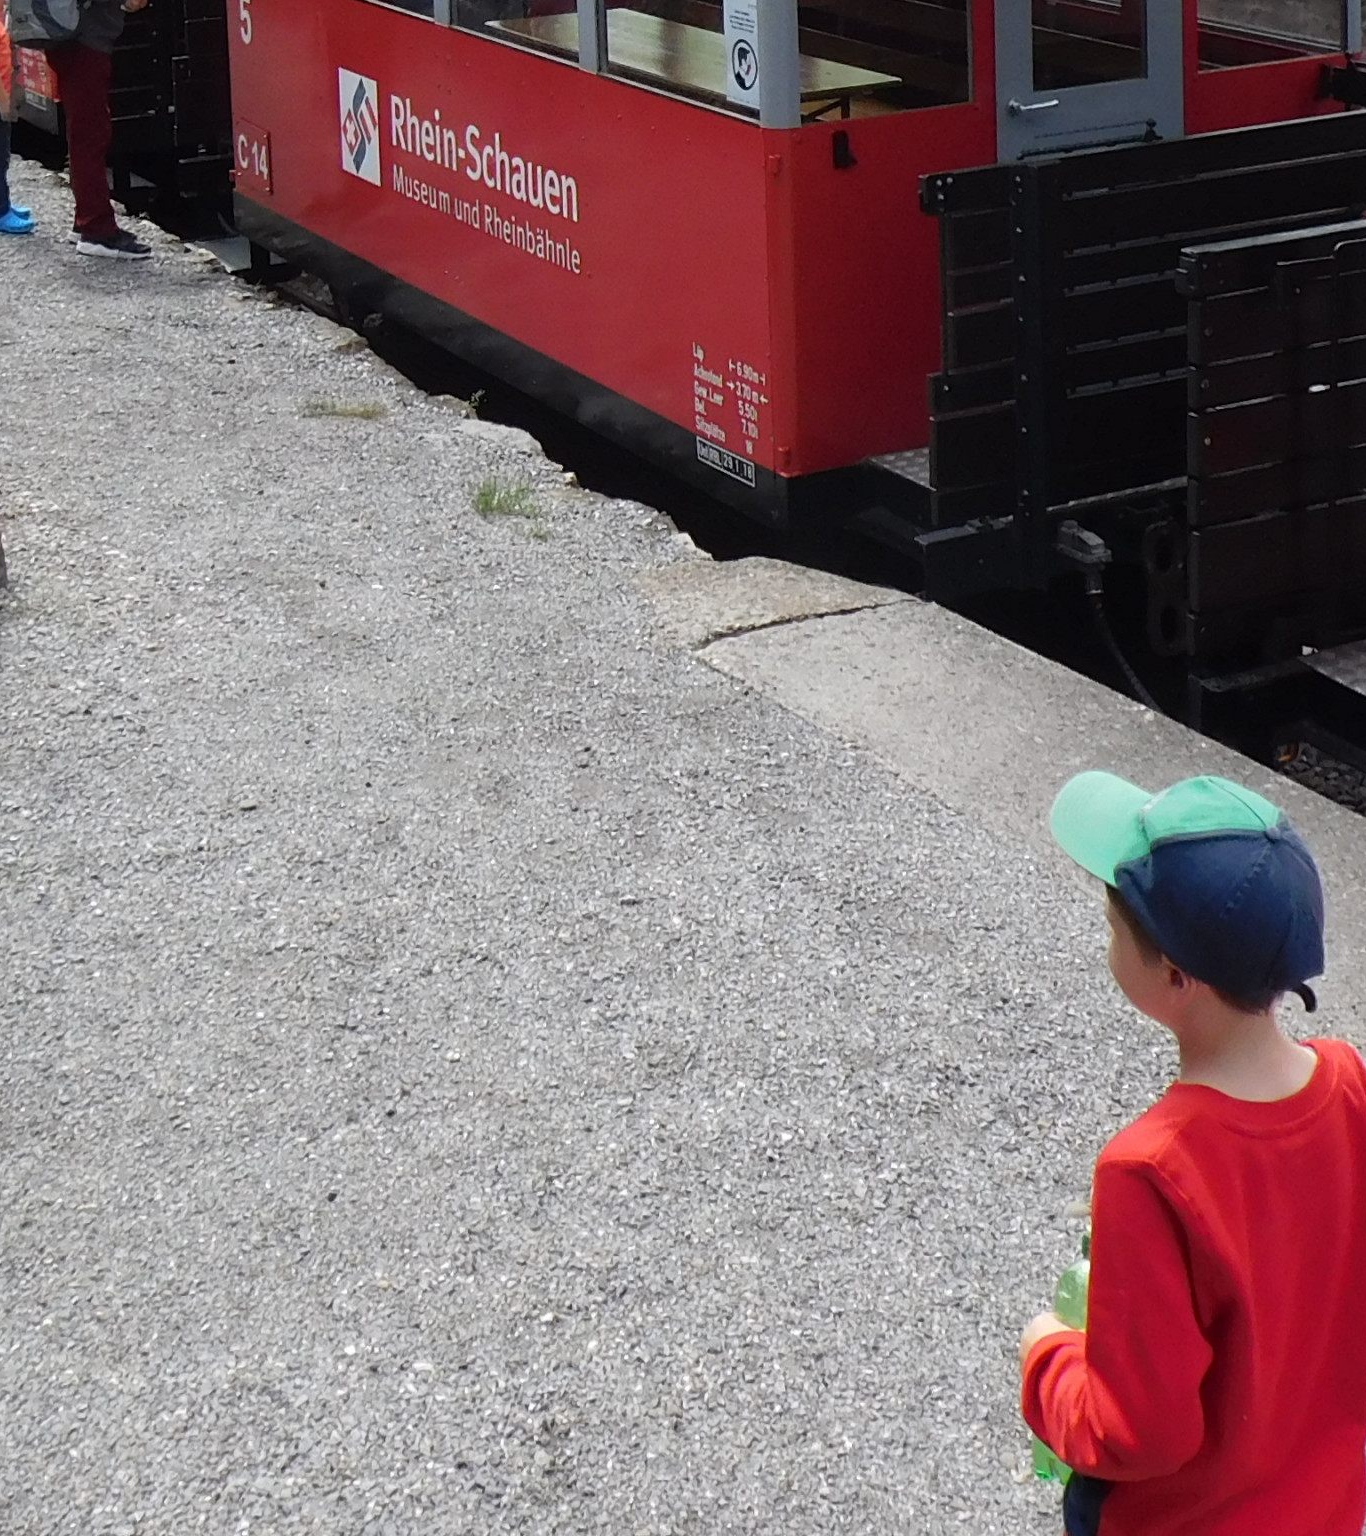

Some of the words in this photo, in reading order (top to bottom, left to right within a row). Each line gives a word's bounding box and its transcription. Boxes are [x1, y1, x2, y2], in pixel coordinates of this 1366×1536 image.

[237, 134, 249, 169] C
[251, 140, 269, 181] 14
[390, 93, 579, 223] Rhein-Schauen
[392, 163, 450, 215] Museum
[454, 202, 481, 231] und
[484, 203, 581, 275] Rheinbähnle
